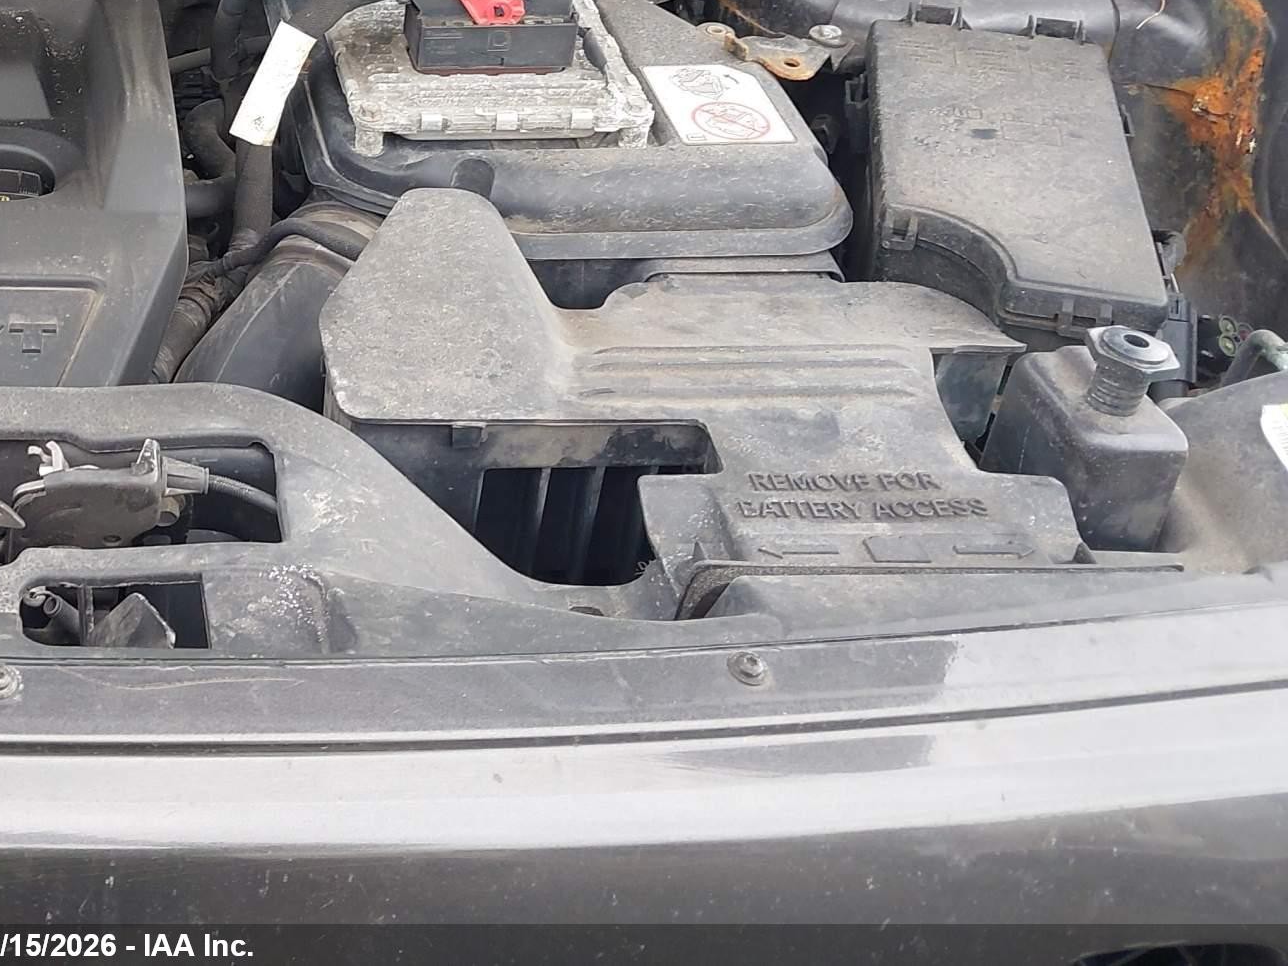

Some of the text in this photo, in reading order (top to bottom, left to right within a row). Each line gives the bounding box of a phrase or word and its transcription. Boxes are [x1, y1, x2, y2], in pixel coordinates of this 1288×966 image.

[747, 471, 943, 492] REMOVE FOR
[736, 497, 990, 520] BATTERY ACCESS
